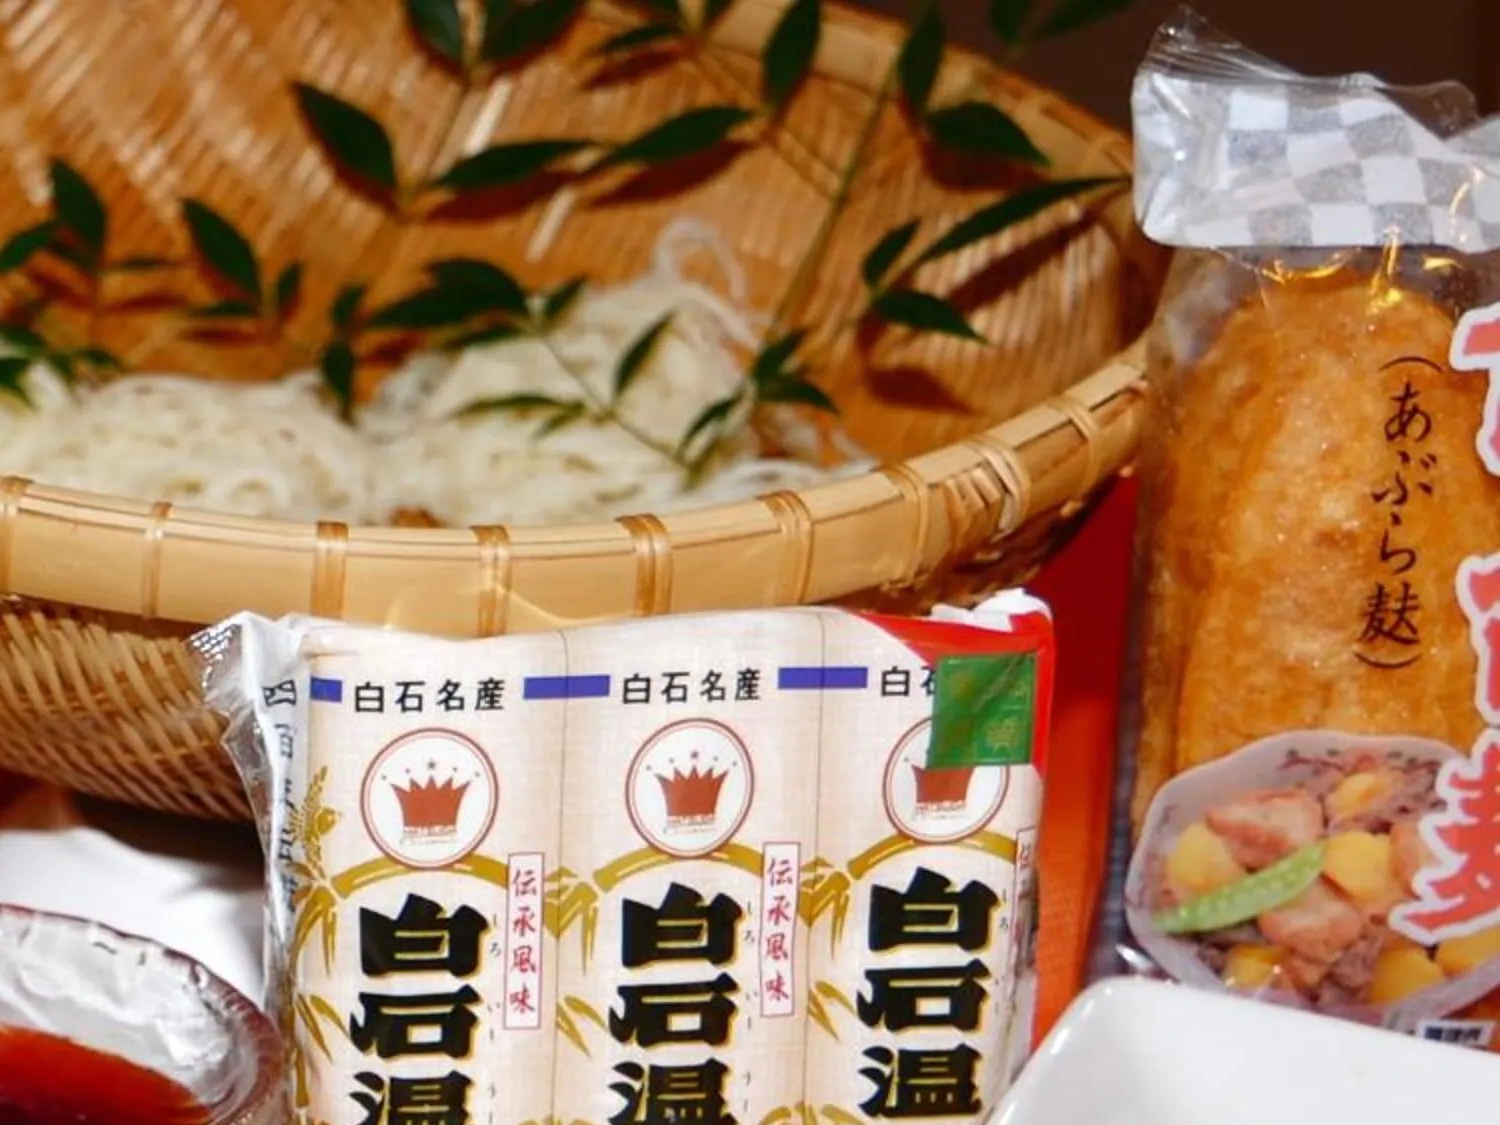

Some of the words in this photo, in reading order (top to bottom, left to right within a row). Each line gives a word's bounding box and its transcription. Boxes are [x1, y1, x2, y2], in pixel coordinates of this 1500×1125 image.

[354, 678, 505, 713] 白石名産
[622, 667, 762, 704] 白石名産
[510, 868, 537, 1015] 伝承風味
[764, 857, 794, 1003] 伝承風味
